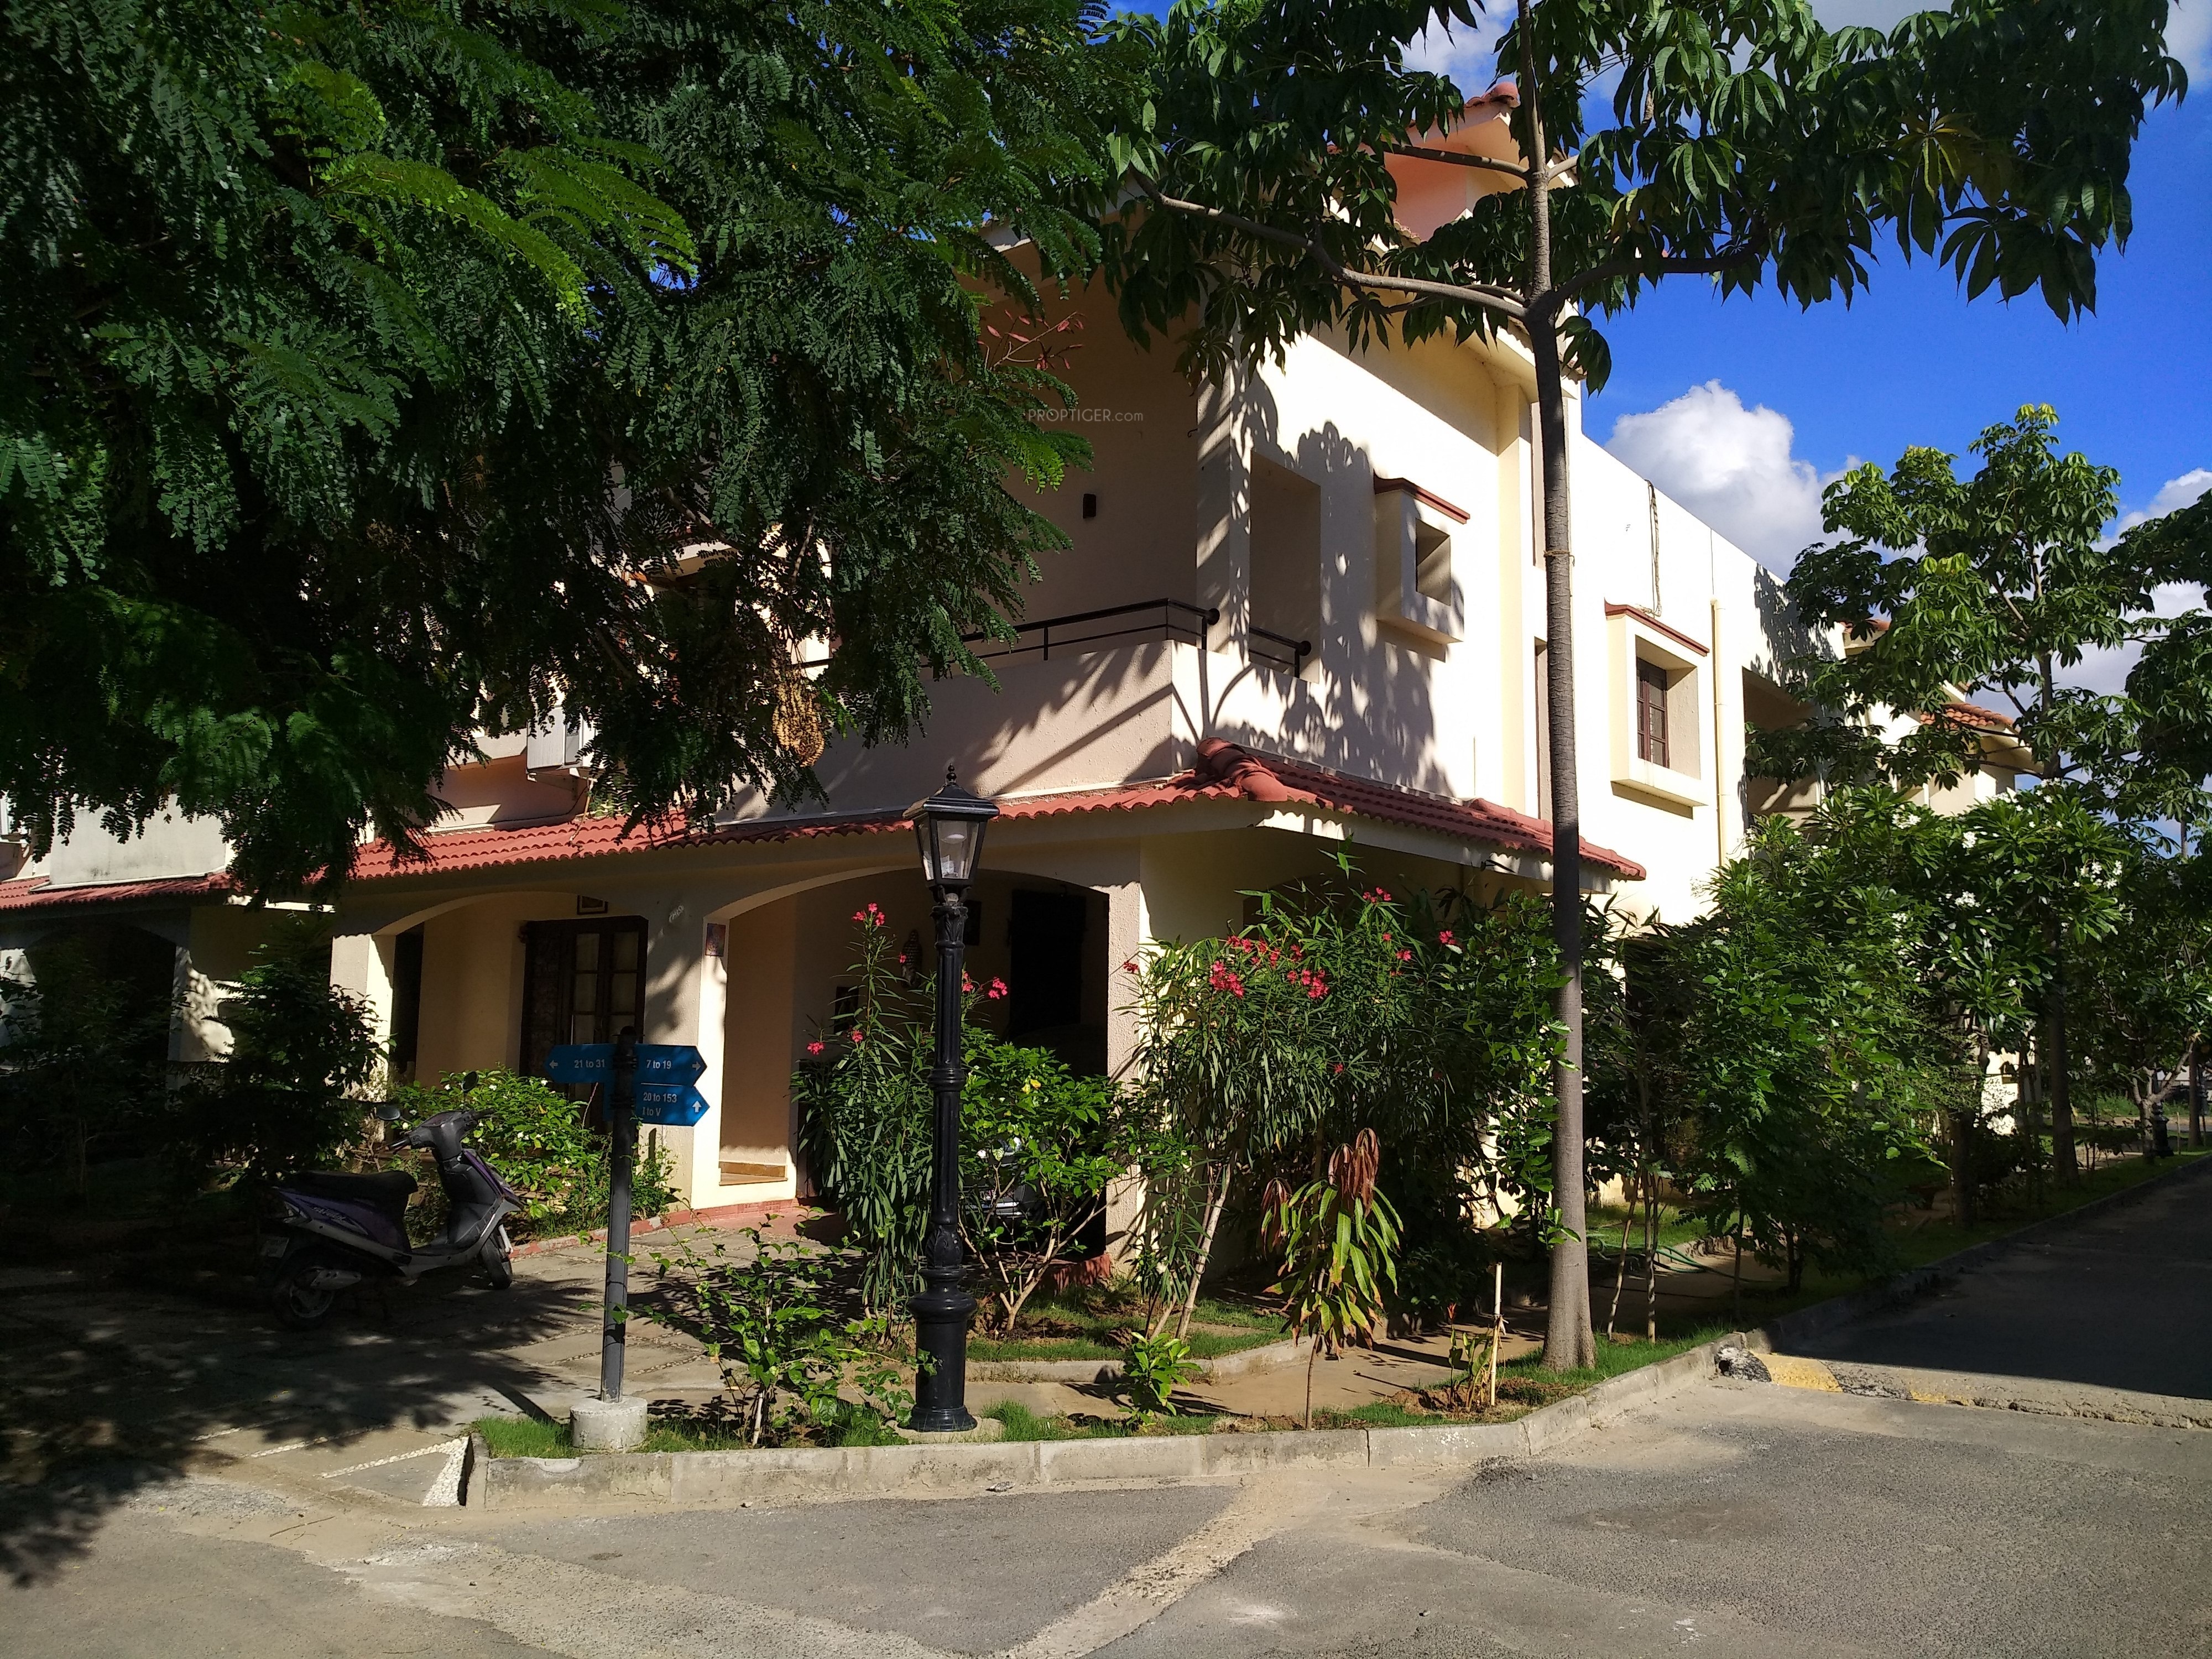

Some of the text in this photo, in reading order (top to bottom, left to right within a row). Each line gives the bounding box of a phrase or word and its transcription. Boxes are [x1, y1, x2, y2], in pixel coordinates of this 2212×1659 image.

[574, 1059, 605, 1069] 21 to 31
[646, 1060, 672, 1070] 7 to 19
[643, 1092, 677, 1103] 20 to 153
[646, 1107, 654, 1116] to
[655, 1107, 661, 1117] V
